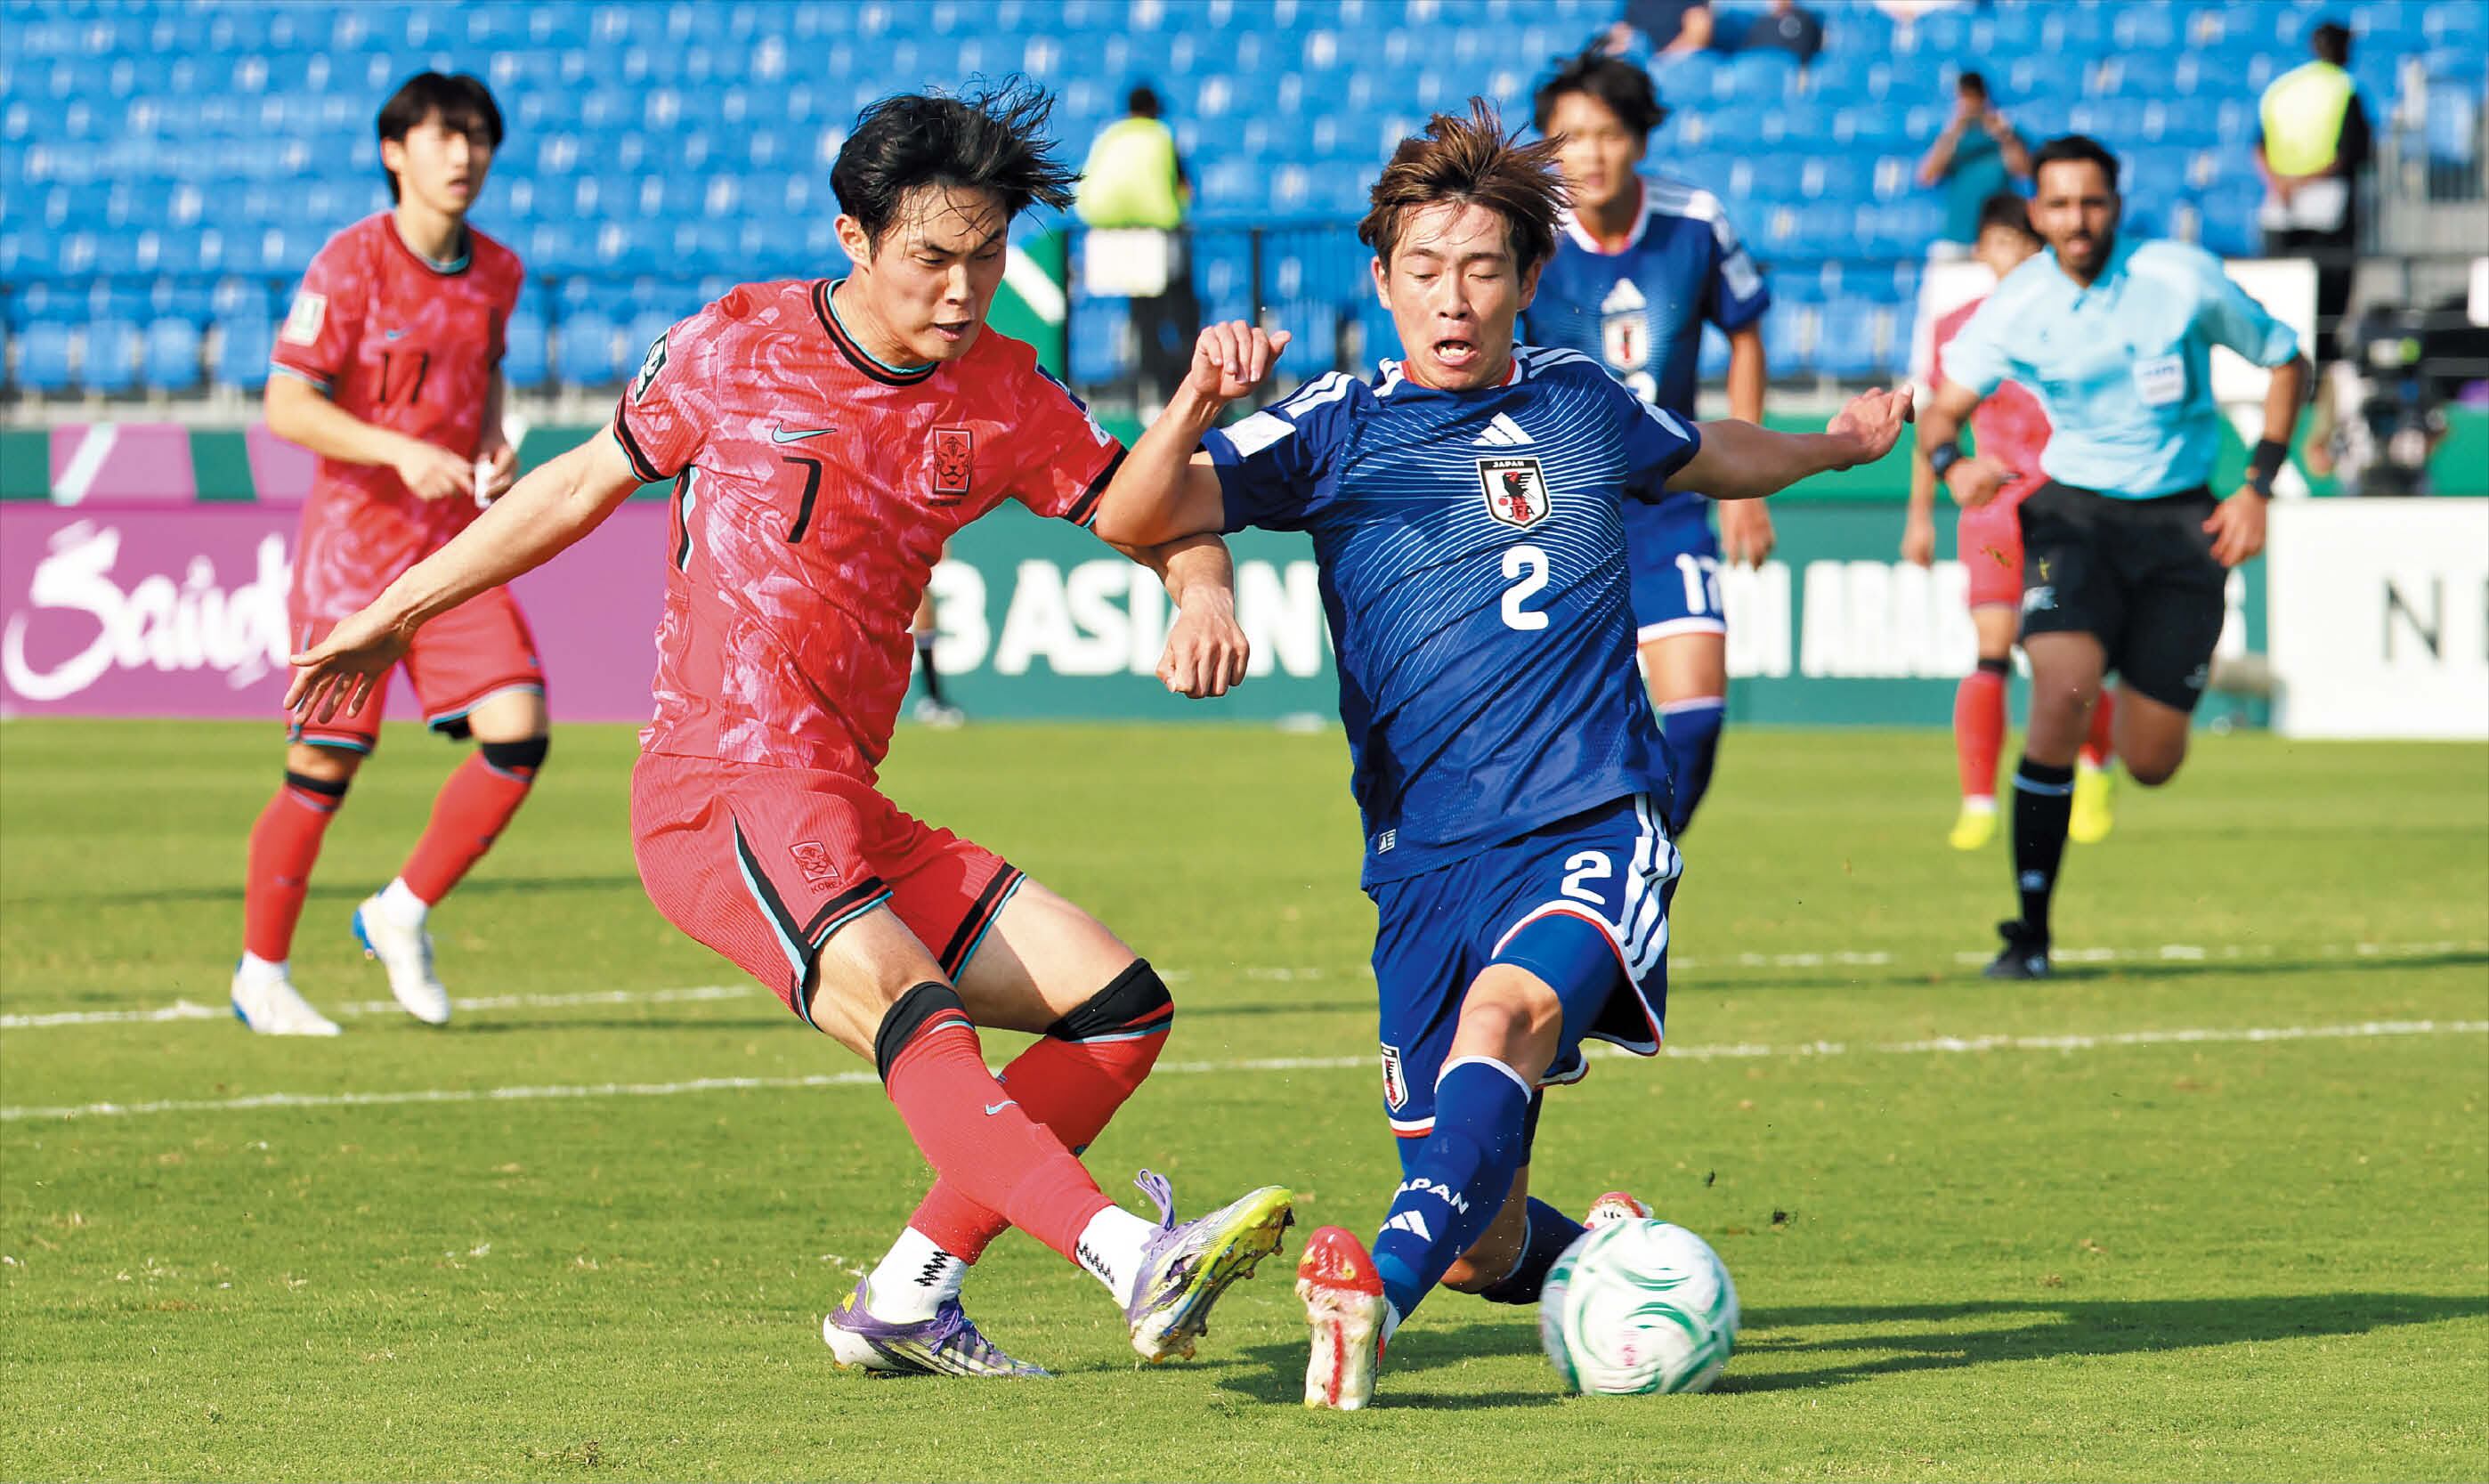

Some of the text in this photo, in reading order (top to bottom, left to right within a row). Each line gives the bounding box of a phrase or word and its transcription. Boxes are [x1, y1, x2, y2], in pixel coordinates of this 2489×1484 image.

[378, 352, 431, 404] 17
[781, 457, 823, 543] 7
[1493, 460, 1525, 468] JAPAN
[1508, 505, 1536, 517] JFA
[4, 522, 293, 701] Saud
[993, 560, 1321, 677] ASIN
[1502, 545, 1550, 631] 2
[2381, 575, 2489, 664] N
[1561, 850, 1612, 905] 2
